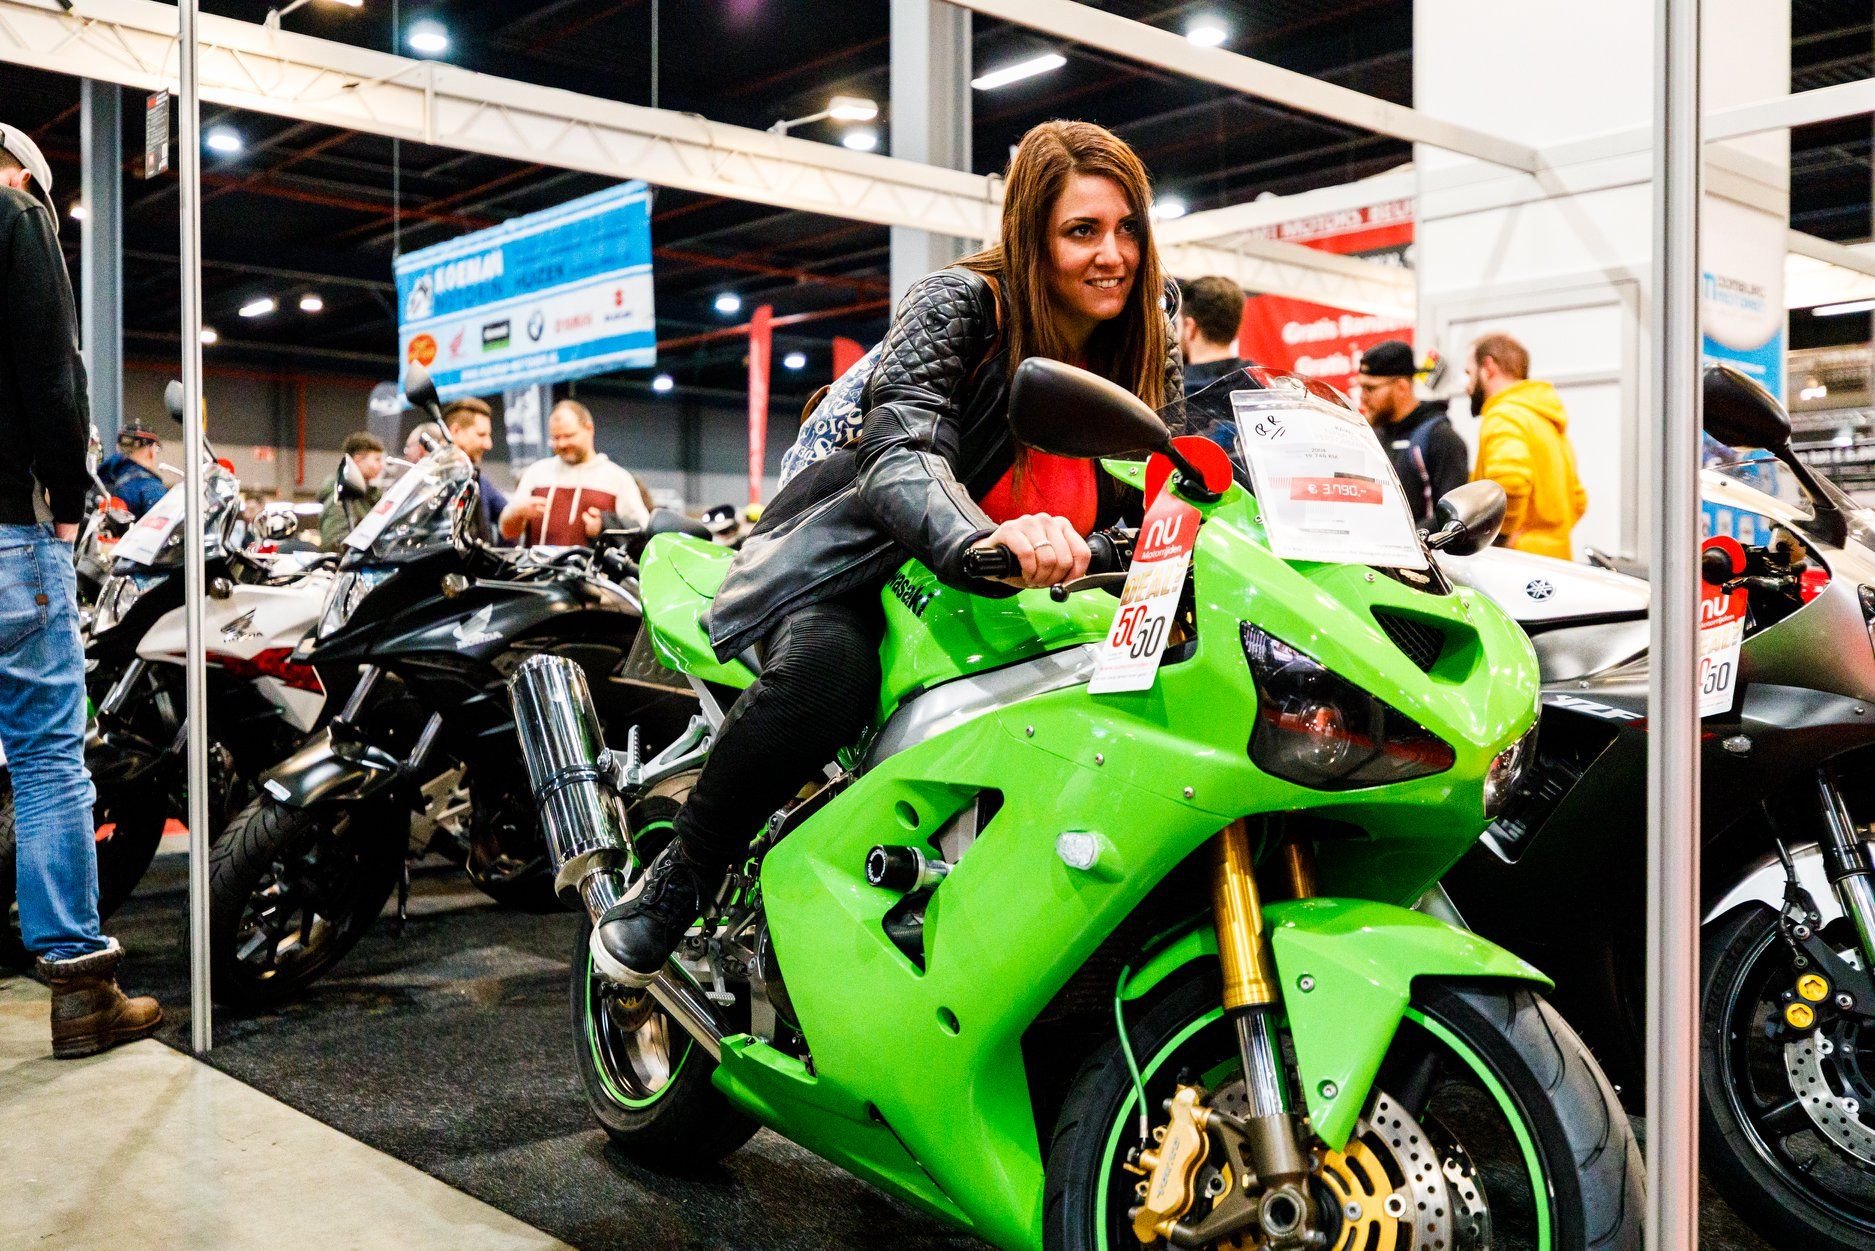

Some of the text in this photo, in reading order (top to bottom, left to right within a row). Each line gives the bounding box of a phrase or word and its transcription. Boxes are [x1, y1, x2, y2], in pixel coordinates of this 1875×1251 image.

[1129, 616, 1166, 659] 50
[1700, 614, 1735, 628] otorrijden
[1703, 661, 1731, 695] 50
